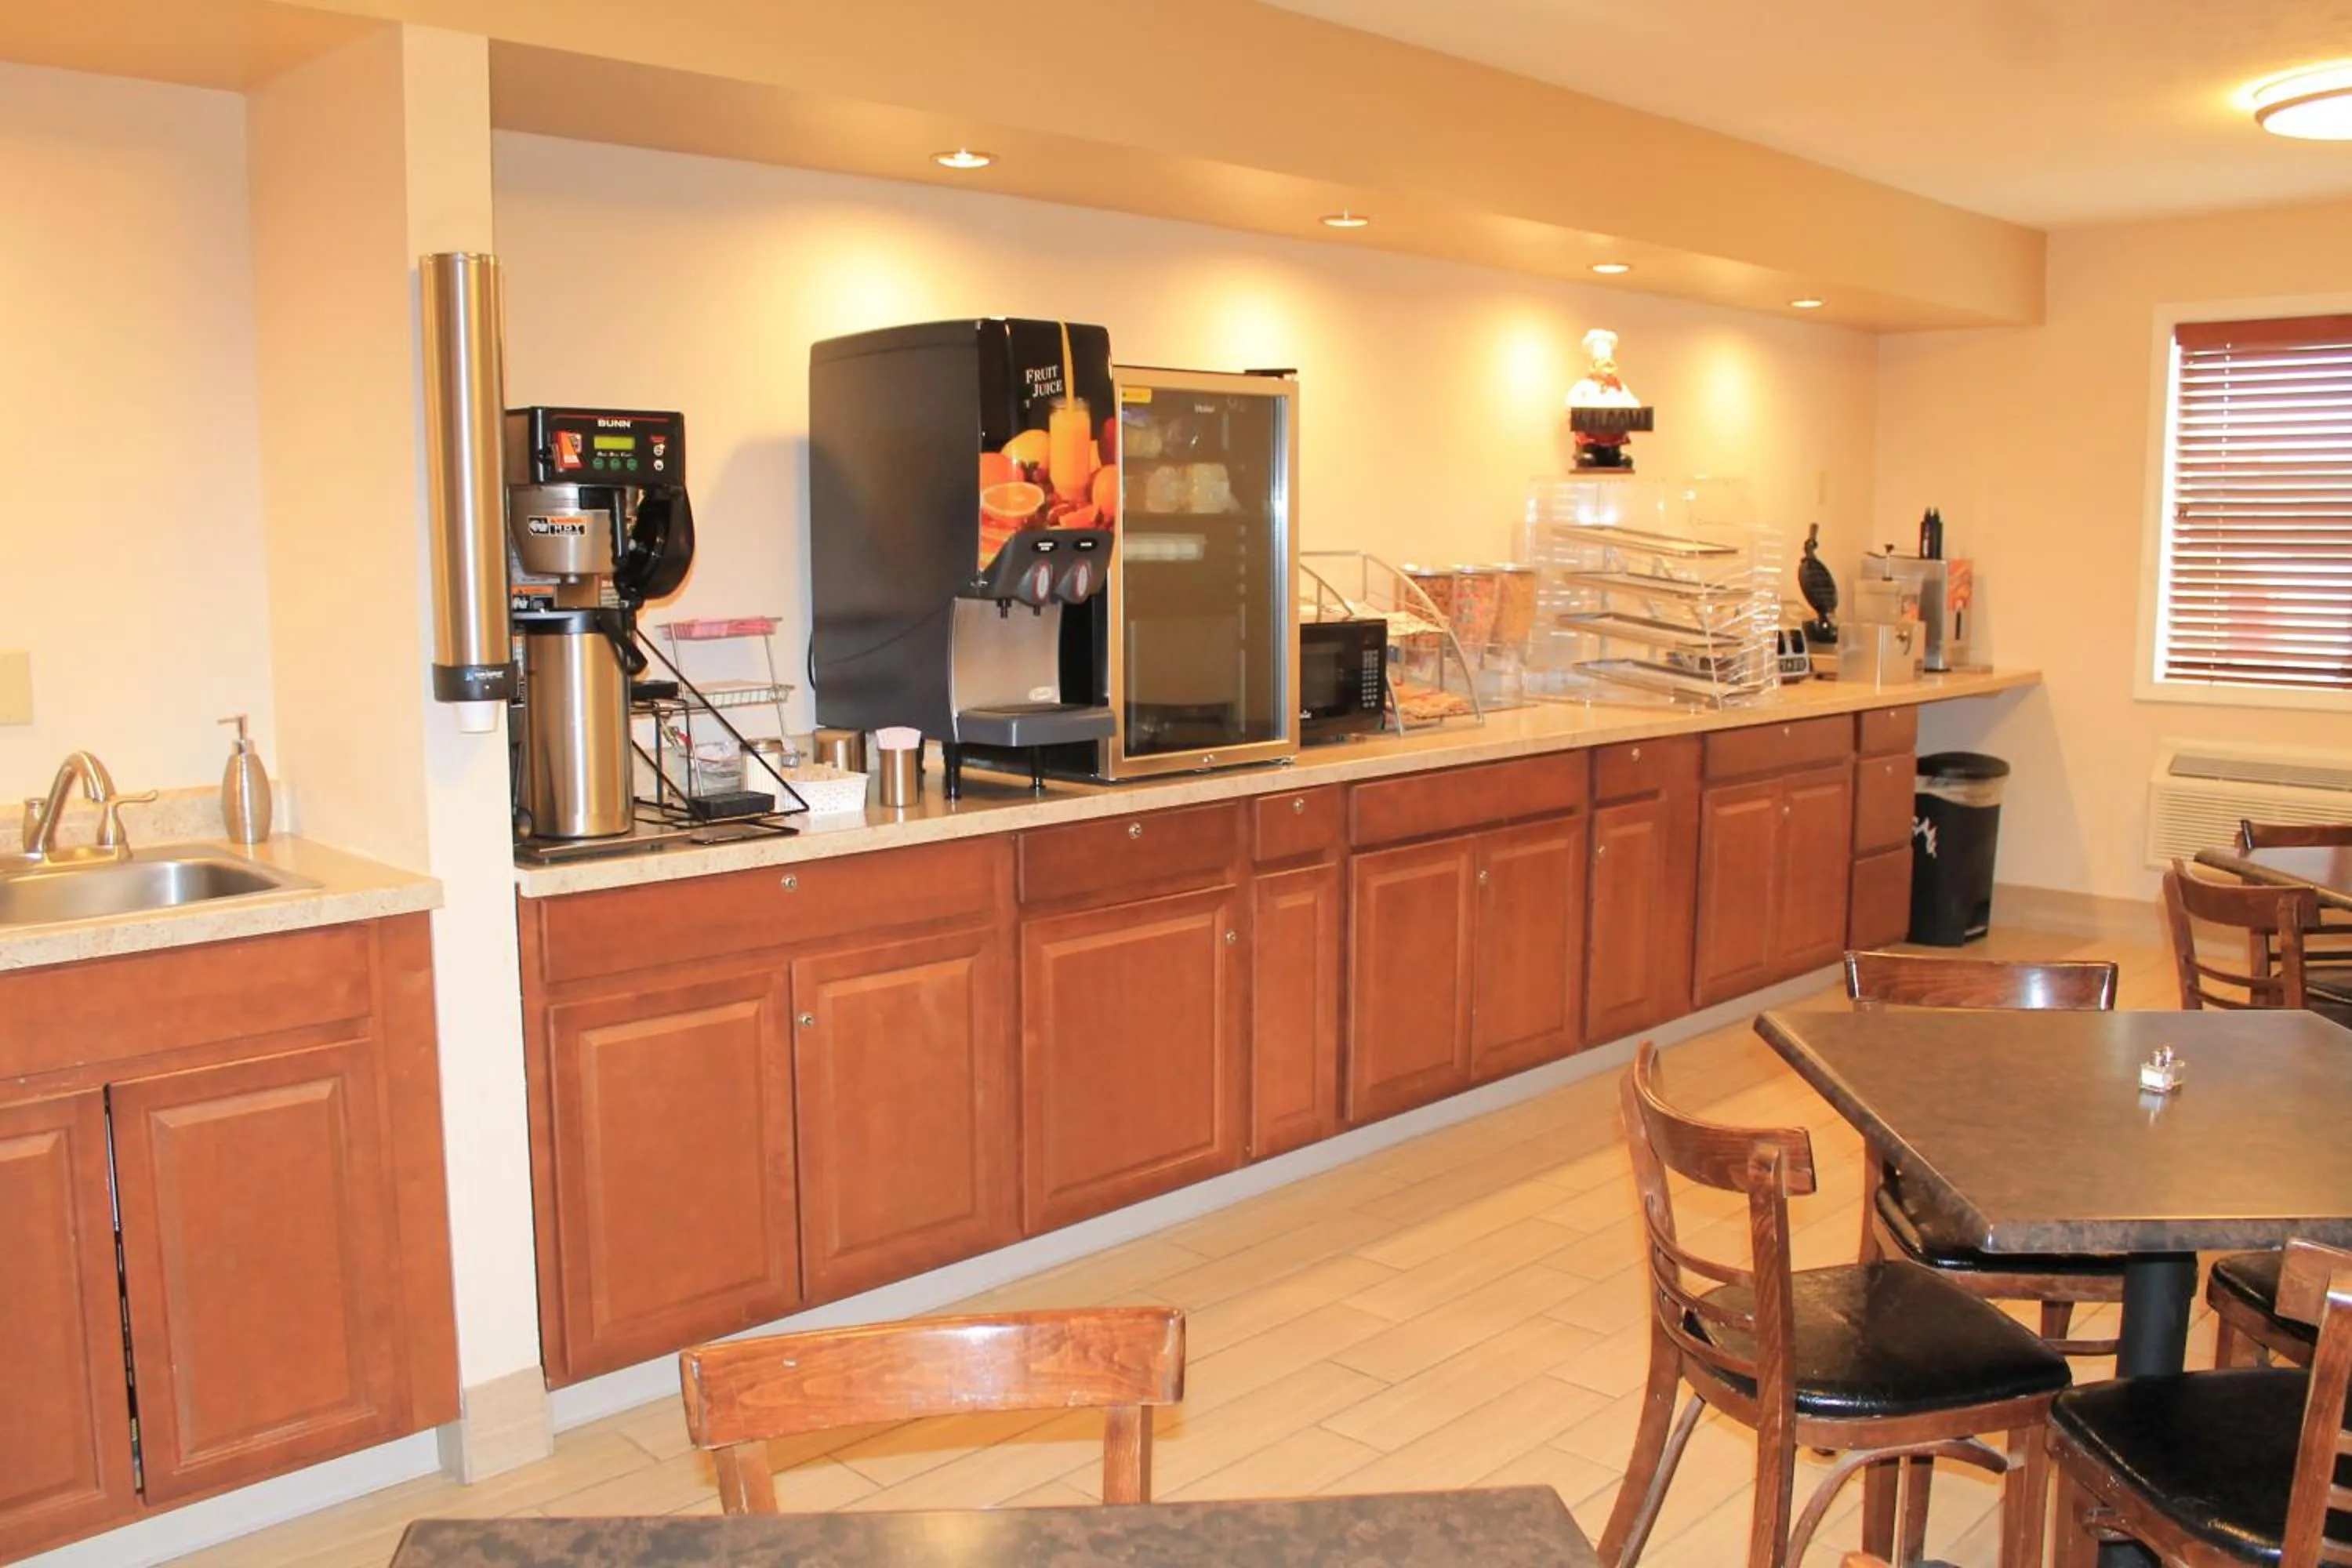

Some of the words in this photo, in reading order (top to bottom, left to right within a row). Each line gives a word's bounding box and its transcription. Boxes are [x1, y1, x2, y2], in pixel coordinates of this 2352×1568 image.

[1025, 364, 1059, 384] FRUIT
[1032, 379, 1062, 397] JUICE
[597, 419, 631, 428] BUNN
